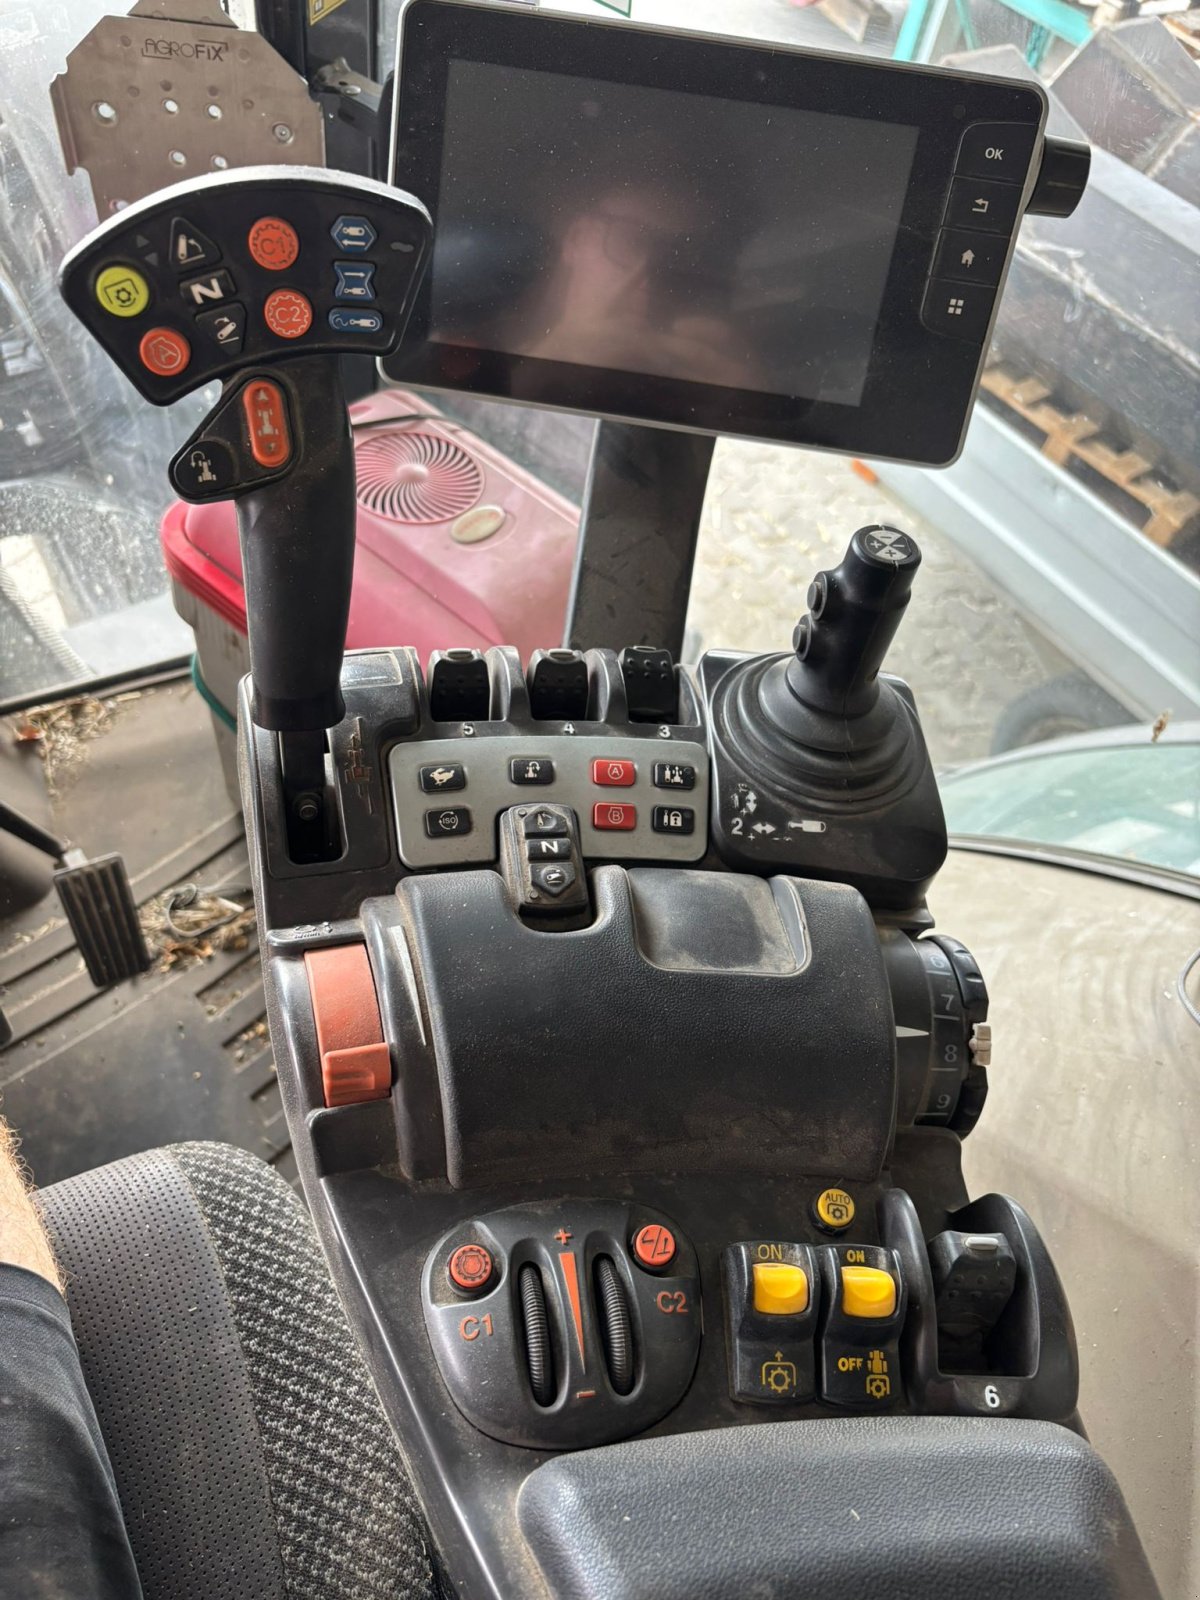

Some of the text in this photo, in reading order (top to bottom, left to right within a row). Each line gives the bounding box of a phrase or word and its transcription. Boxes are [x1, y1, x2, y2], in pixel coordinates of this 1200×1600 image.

[985, 147, 1004, 161] OK
[261, 237, 286, 256] C1
[190, 278, 224, 304] N
[275, 306, 301, 323] C2
[463, 722, 475, 736] 5
[564, 722, 575, 735] 4
[660, 725, 671, 738] 3
[611, 767, 620, 776] A
[442, 817, 456, 825] ISO
[612, 810, 622, 821] B
[731, 817, 744, 836] 2
[541, 840, 559, 853] N
[940, 993, 955, 1011] 7
[944, 1044, 958, 1063] 8
[936, 1094, 951, 1109] 9
[825, 1192, 851, 1205] AUTO
[757, 1244, 783, 1260] ON
[846, 1249, 865, 1263] ON
[656, 1291, 689, 1313] C2
[458, 1313, 494, 1342] C1
[837, 1357, 863, 1372] OFF
[984, 1385, 1001, 1408] 6
